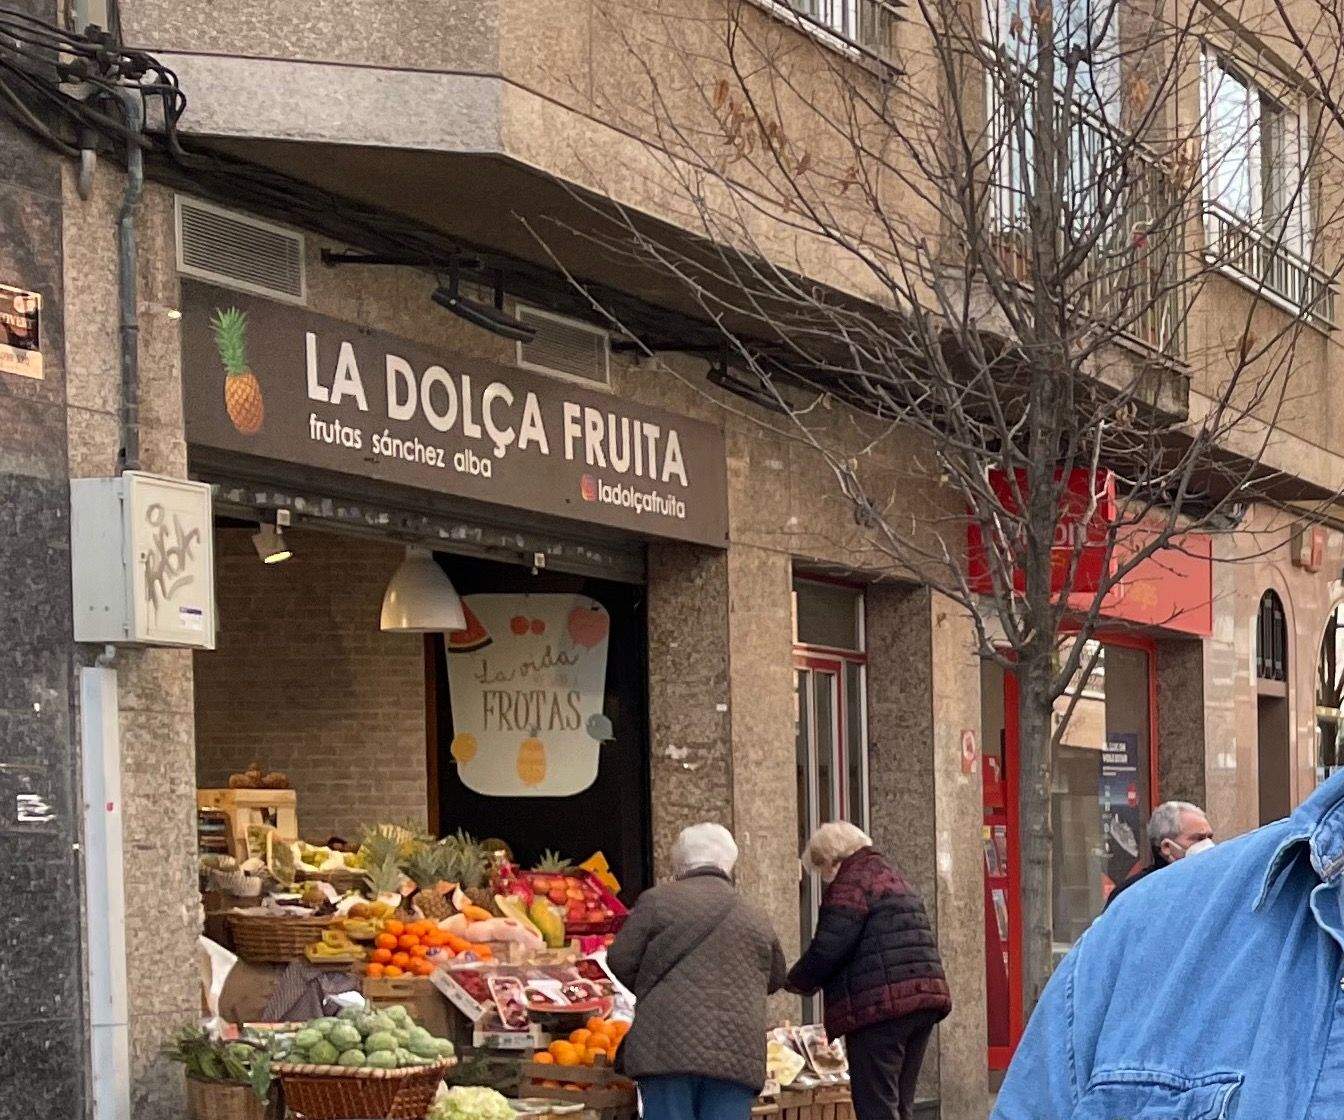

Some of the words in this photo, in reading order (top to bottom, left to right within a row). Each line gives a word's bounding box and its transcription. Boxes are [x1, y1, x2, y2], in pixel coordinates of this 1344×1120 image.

[306, 331, 368, 411] LA
[386, 354, 549, 458] DOLÇA
[563, 401, 688, 487] FRUITA
[309, 413, 362, 450] frutas
[372, 430, 445, 470] sánchez
[453, 449, 492, 479] alba
[598, 479, 686, 519] ladolçafruita
